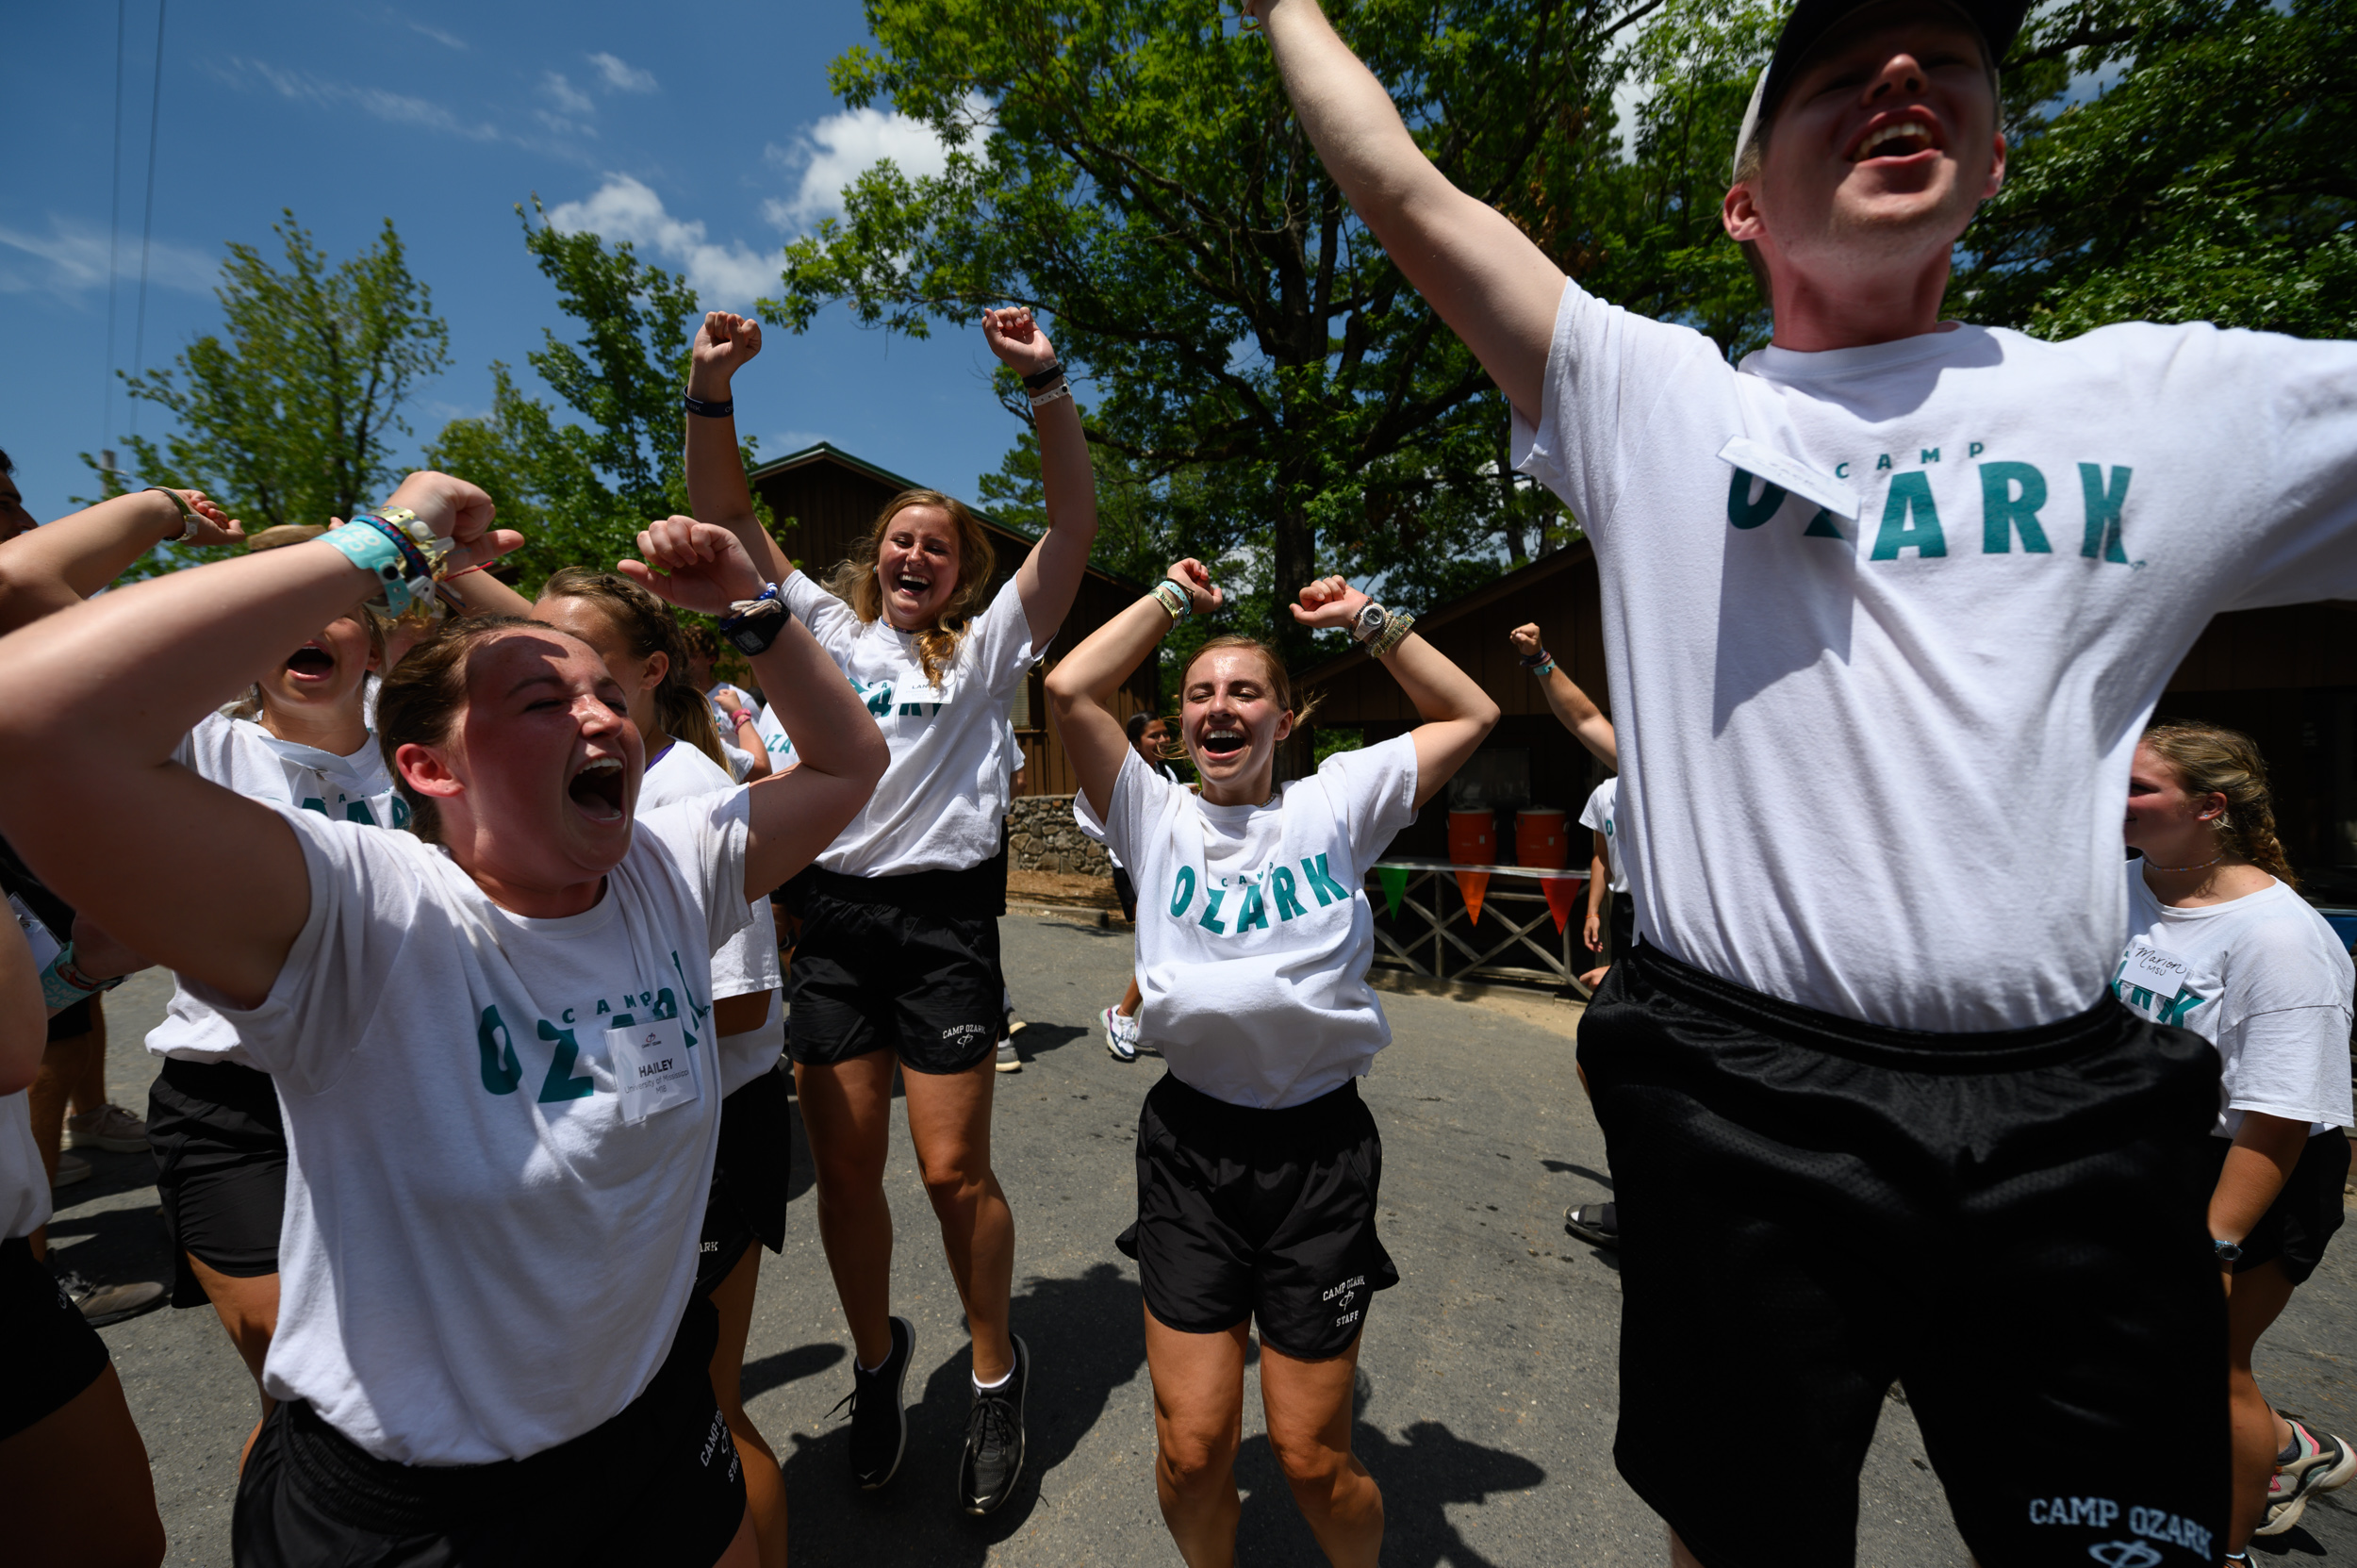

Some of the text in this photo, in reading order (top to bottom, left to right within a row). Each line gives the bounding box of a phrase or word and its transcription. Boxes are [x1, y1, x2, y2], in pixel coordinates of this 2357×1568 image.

[1836, 441, 1985, 479] CAMP
[1170, 851, 1350, 934] OZARK
[2134, 946, 2187, 975] Marion
[2146, 965, 2167, 977] MSU
[562, 990, 652, 1025] CAMP
[942, 1024, 986, 1039] CAMP OZARK
[624, 1067, 689, 1095] University of Mississippi
[638, 1057, 674, 1079] HAILEY
[1323, 1275, 1366, 1301] CAMP OZARK
[1336, 1310, 1360, 1328] STAFF
[700, 1423, 720, 1468] CAMP
[2029, 1495, 2214, 1561] CAMP OZARK
